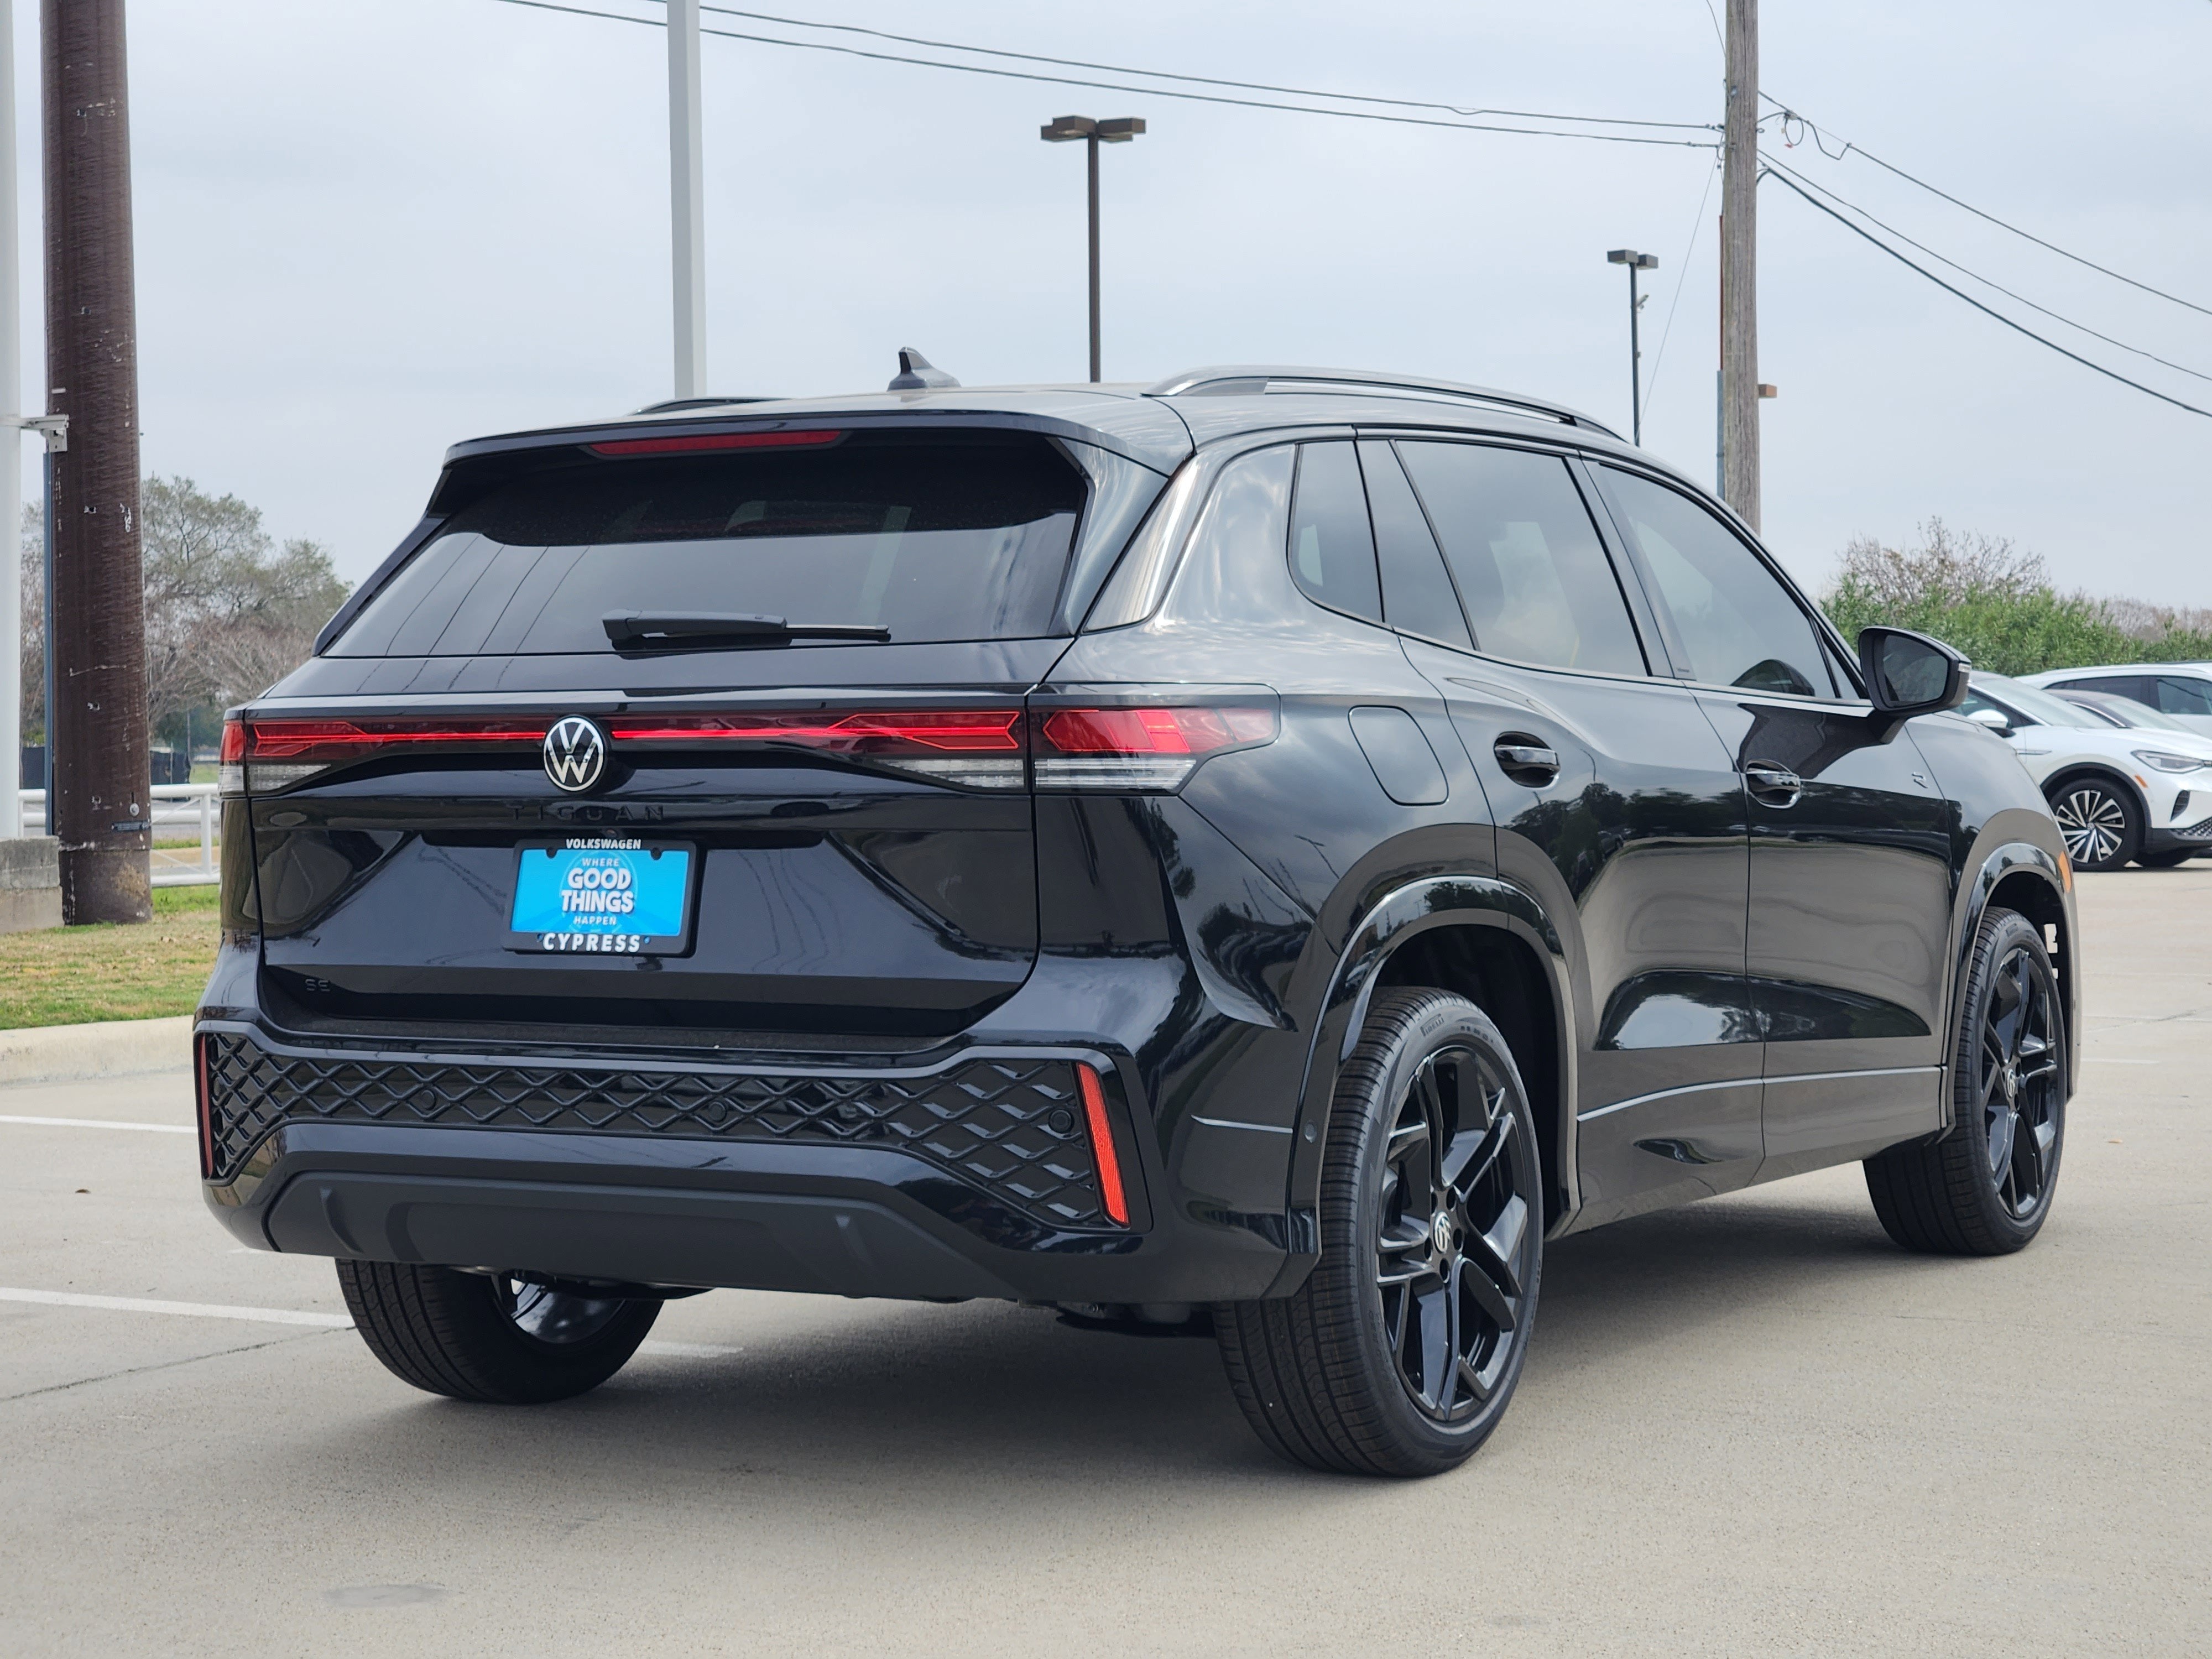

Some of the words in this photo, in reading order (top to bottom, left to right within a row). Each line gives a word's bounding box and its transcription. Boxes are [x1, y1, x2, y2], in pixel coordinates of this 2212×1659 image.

[544, 717, 603, 791] VW
[505, 804, 664, 821] TIGUAN
[566, 838, 641, 849] VOLKSWAGEN
[581, 858, 620, 867] WHERE
[567, 867, 632, 890] GOOD
[561, 889, 635, 913] THINGS
[573, 915, 617, 926] HAPPEN
[543, 932, 640, 953] CYPRESS
[305, 978, 331, 992] SE
